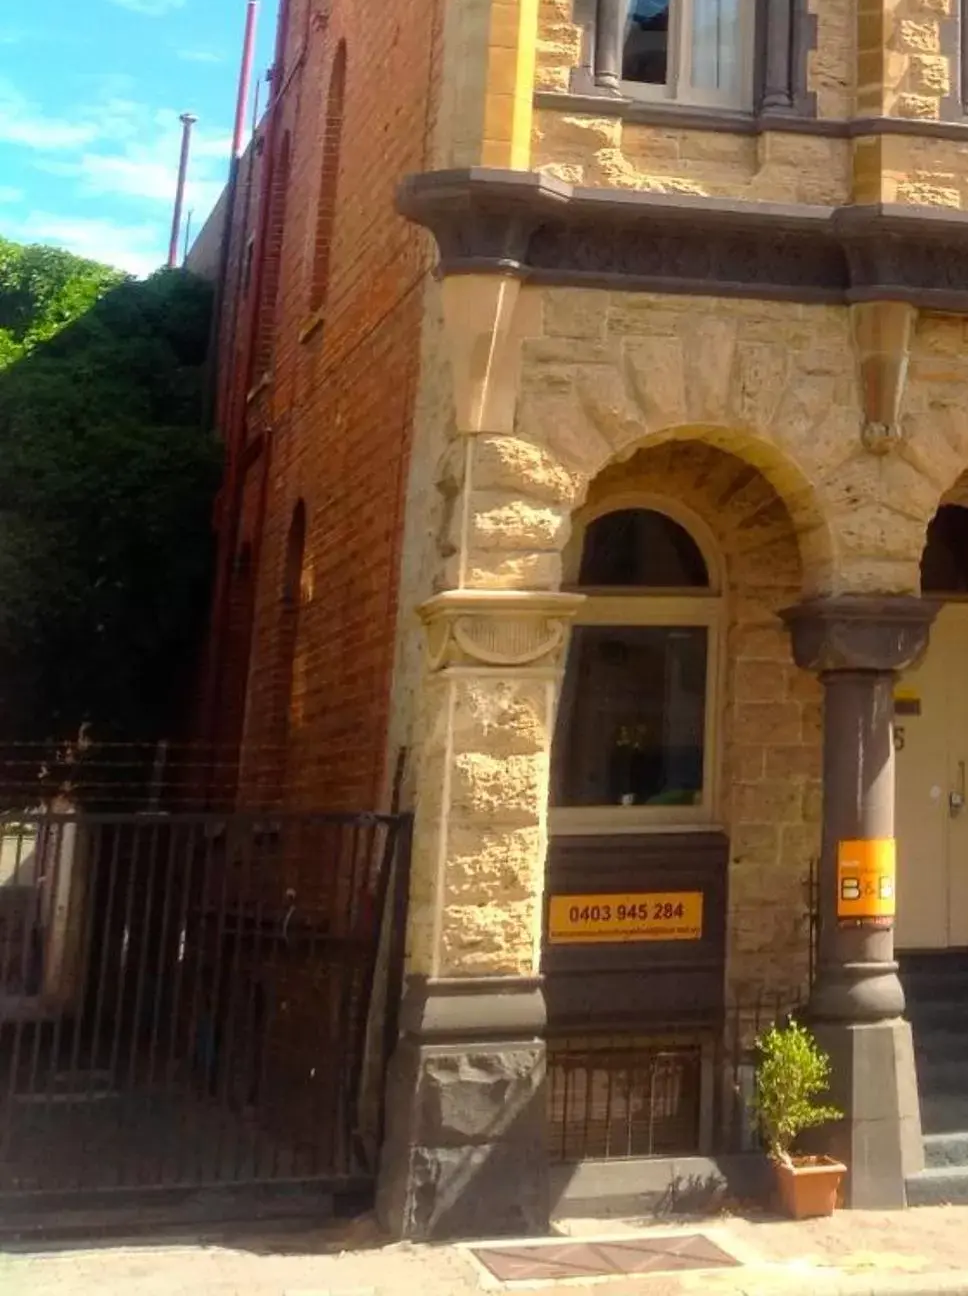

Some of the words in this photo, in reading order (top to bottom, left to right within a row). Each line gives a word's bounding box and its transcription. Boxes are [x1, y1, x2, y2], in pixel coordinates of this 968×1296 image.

[569, 905, 612, 923] 0403
[617, 903, 648, 922] 945
[653, 901, 684, 920] 284
